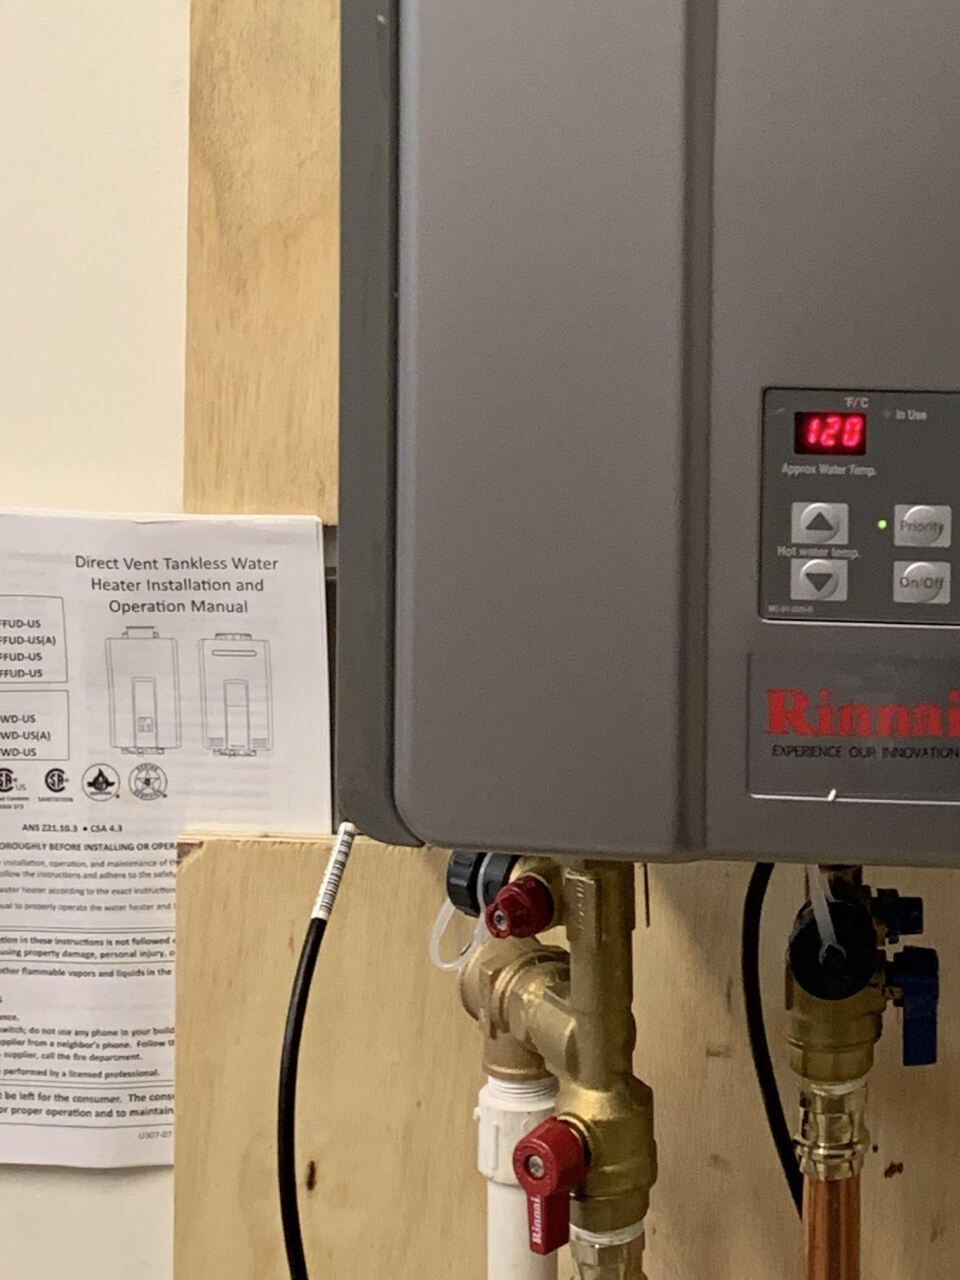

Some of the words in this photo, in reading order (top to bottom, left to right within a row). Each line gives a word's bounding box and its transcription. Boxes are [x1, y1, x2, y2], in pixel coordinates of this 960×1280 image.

[896, 409, 906, 420] In
[908, 410, 928, 421] Use
[807, 416, 863, 446] 120
[819, 464, 848, 474] Water
[850, 464, 877, 476] Temp.
[900, 520, 944, 534] Priority
[777, 546, 797, 556] Hot
[800, 547, 828, 557] water
[832, 547, 861, 560] temp.
[75, 555, 119, 570] Direct
[123, 557, 158, 570] Vent
[163, 556, 228, 570] Tankless
[231, 557, 279, 570] Water
[91, 577, 142, 592] Heater
[147, 577, 231, 592] Installation
[236, 578, 264, 592] and
[900, 577, 944, 589] On/Off
[109, 600, 186, 616] Operation
[191, 600, 248, 614] Manual
[0, 715, 36, 724] WD-US
[0, 731, 51, 742] WD-US(A)
[772, 745, 842, 758] EXPERIENCE
[849, 746, 876, 758] OUR
[881, 746, 960, 759] INNOVATION
[22, 824, 40, 832] ANS
[42, 824, 78, 833] Z21.10.3
[90, 824, 107, 833] CSA
[109, 824, 123, 832] 4.3
[49, 843, 81, 851] BEFORE
[84, 842, 135, 851] INSTALLING
[107, 860, 157, 868] maintenance
[134, 886, 176, 894] instruction
[55, 937, 104, 945] instructions
[132, 937, 170, 945] followed
[24, 949, 60, 958] property
[62, 949, 97, 959] damage,
[99, 949, 137, 959] personal
[139, 949, 167, 959] injury,
[22, 966, 66, 975] flammable
[68, 970, 96, 978] vapors
[98, 969, 114, 978] and
[116, 969, 145, 978] liquids
[74, 1030, 89, 1038] any
[91, 1029, 118, 1037] phone
[131, 1029, 151, 1037] your
[152, 1027, 176, 1035] build
[27, 1039, 48, 1047] from
[56, 1041, 99, 1050] neighbor's
[102, 1041, 132, 1050] phone.
[136, 1040, 165, 1048] Follow
[41, 1052, 55, 1060] call
[89, 1054, 143, 1063] department.
[3, 1067, 48, 1076] performed
[49, 1069, 60, 1077] by
[68, 1070, 102, 1079] licensed
[104, 1068, 160, 1079] professional.
[4, 1091, 16, 1100] be
[20, 1092, 35, 1100] left
[37, 1092, 51, 1101] for
[54, 1094, 69, 1102] the
[72, 1095, 121, 1103] consumer.
[128, 1093, 147, 1102] The
[11, 1107, 42, 1116] proper
[45, 1108, 92, 1117] operation
[95, 1109, 113, 1117] and
[116, 1109, 127, 1117] to
[129, 1106, 175, 1117] maintain
